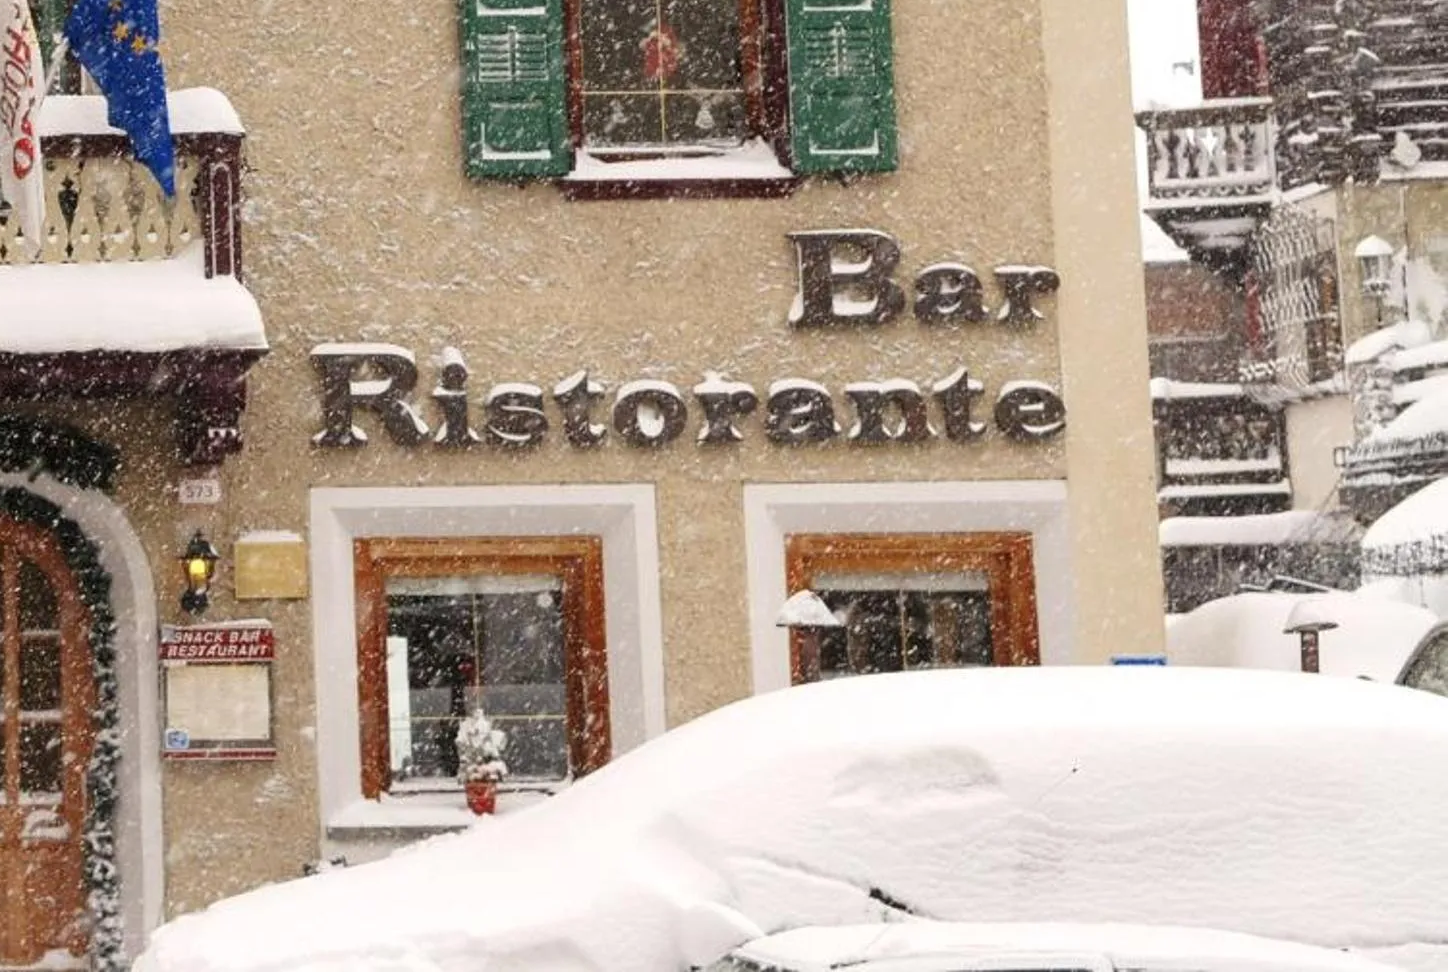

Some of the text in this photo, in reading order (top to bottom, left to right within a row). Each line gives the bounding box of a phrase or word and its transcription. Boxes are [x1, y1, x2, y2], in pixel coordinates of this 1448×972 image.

[787, 228, 1059, 329] Bar
[310, 343, 1067, 448] Ristorante
[167, 643, 269, 658] RESTAURANT
[174, 631, 261, 644] SNACK BAR
